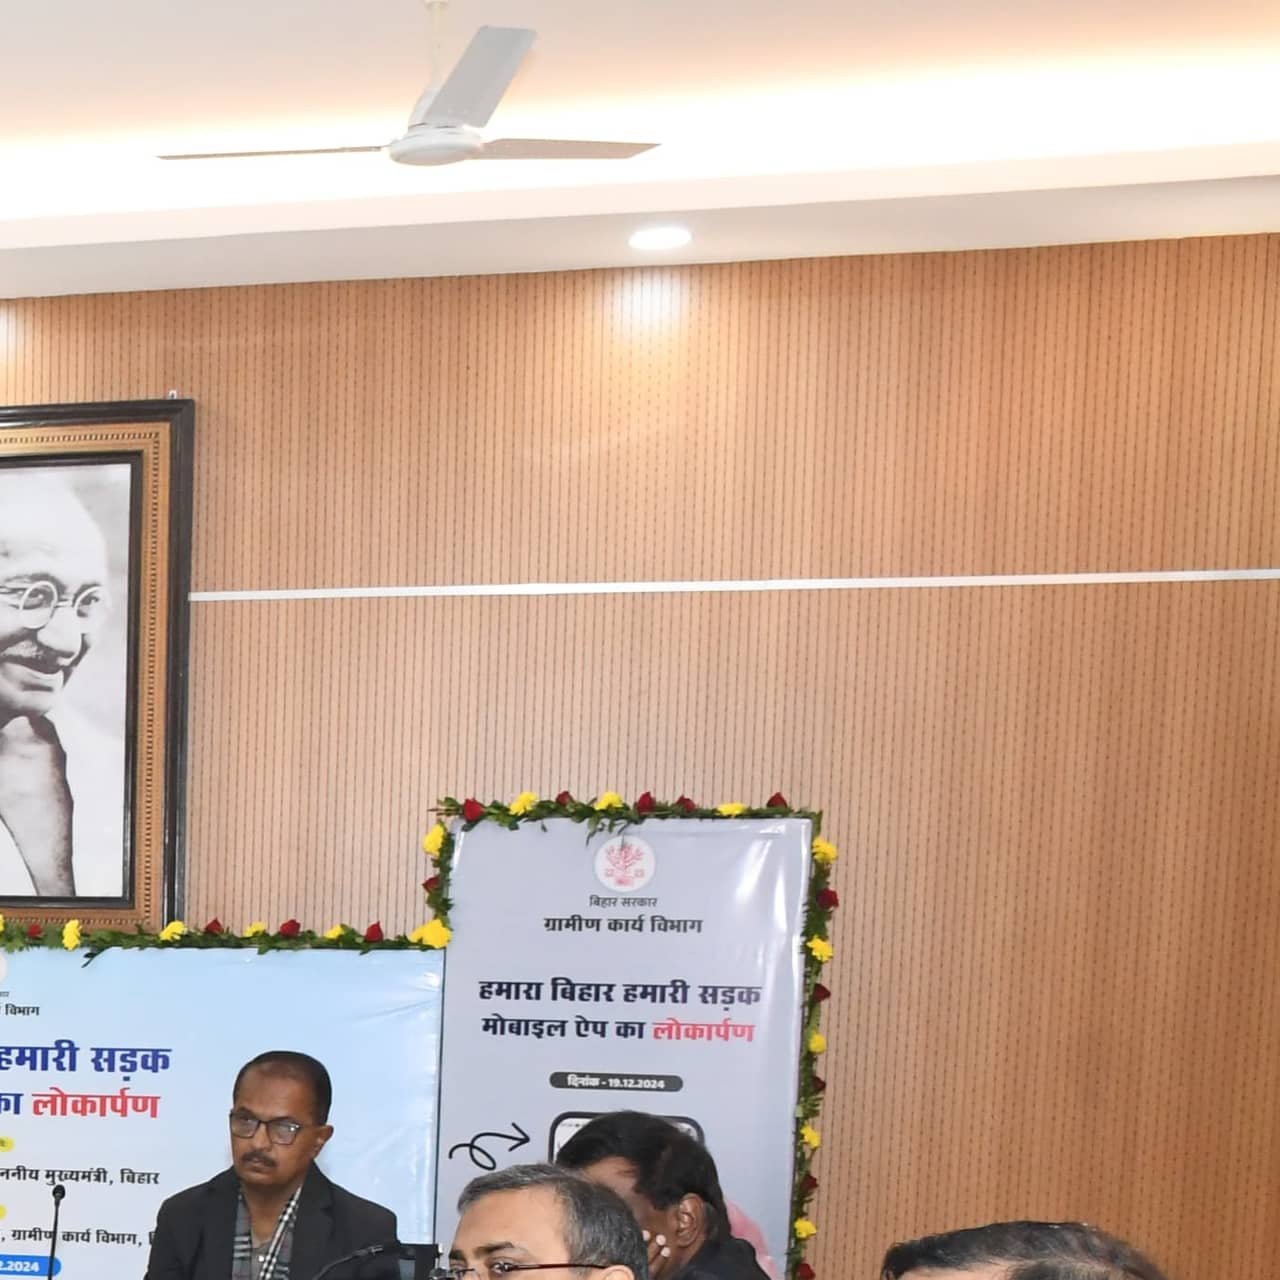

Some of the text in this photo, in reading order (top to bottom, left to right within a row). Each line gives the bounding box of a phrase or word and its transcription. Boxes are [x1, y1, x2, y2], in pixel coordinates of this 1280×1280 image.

[589, 895, 658, 908] बिहार सरकार
[543, 914, 703, 933] ग्रामीण कार्य विभाग
[479, 976, 763, 1011] हमारा बिहार हमारी सड़क
[4, 1003, 40, 1016] विभाग
[481, 1013, 756, 1042] मोबाइल ऐप का लोकार्पण
[90, 1047, 172, 1081] सड़क
[608, 1077, 665, 1090] 19.12.2024
[31, 1086, 161, 1119] लोकार्पण
[45, 1167, 114, 1185] मुख्यमंत्री,
[120, 1168, 160, 1185] बिहार
[11, 1227, 55, 1241] ग्रामीण
[61, 1228, 91, 1243] कार्य
[96, 1229, 142, 1247] विभाग,
